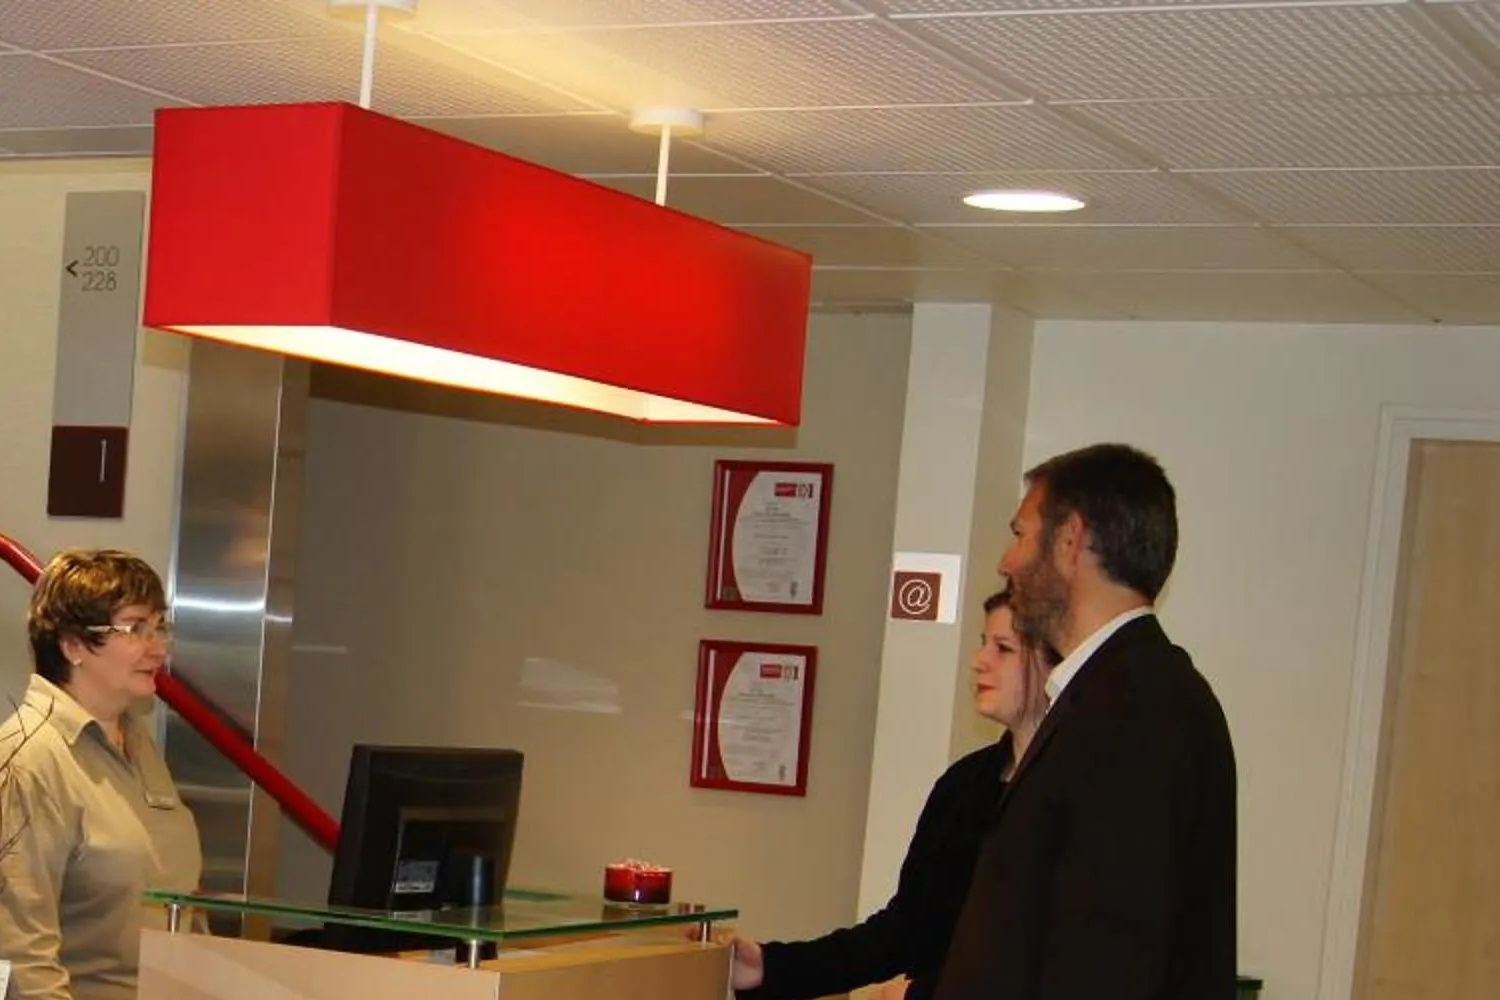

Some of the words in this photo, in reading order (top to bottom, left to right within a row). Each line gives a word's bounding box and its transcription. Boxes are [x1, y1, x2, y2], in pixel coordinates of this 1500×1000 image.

[81, 246, 120, 268] 200
[80, 270, 118, 293] 228
[898, 578, 933, 616] @
